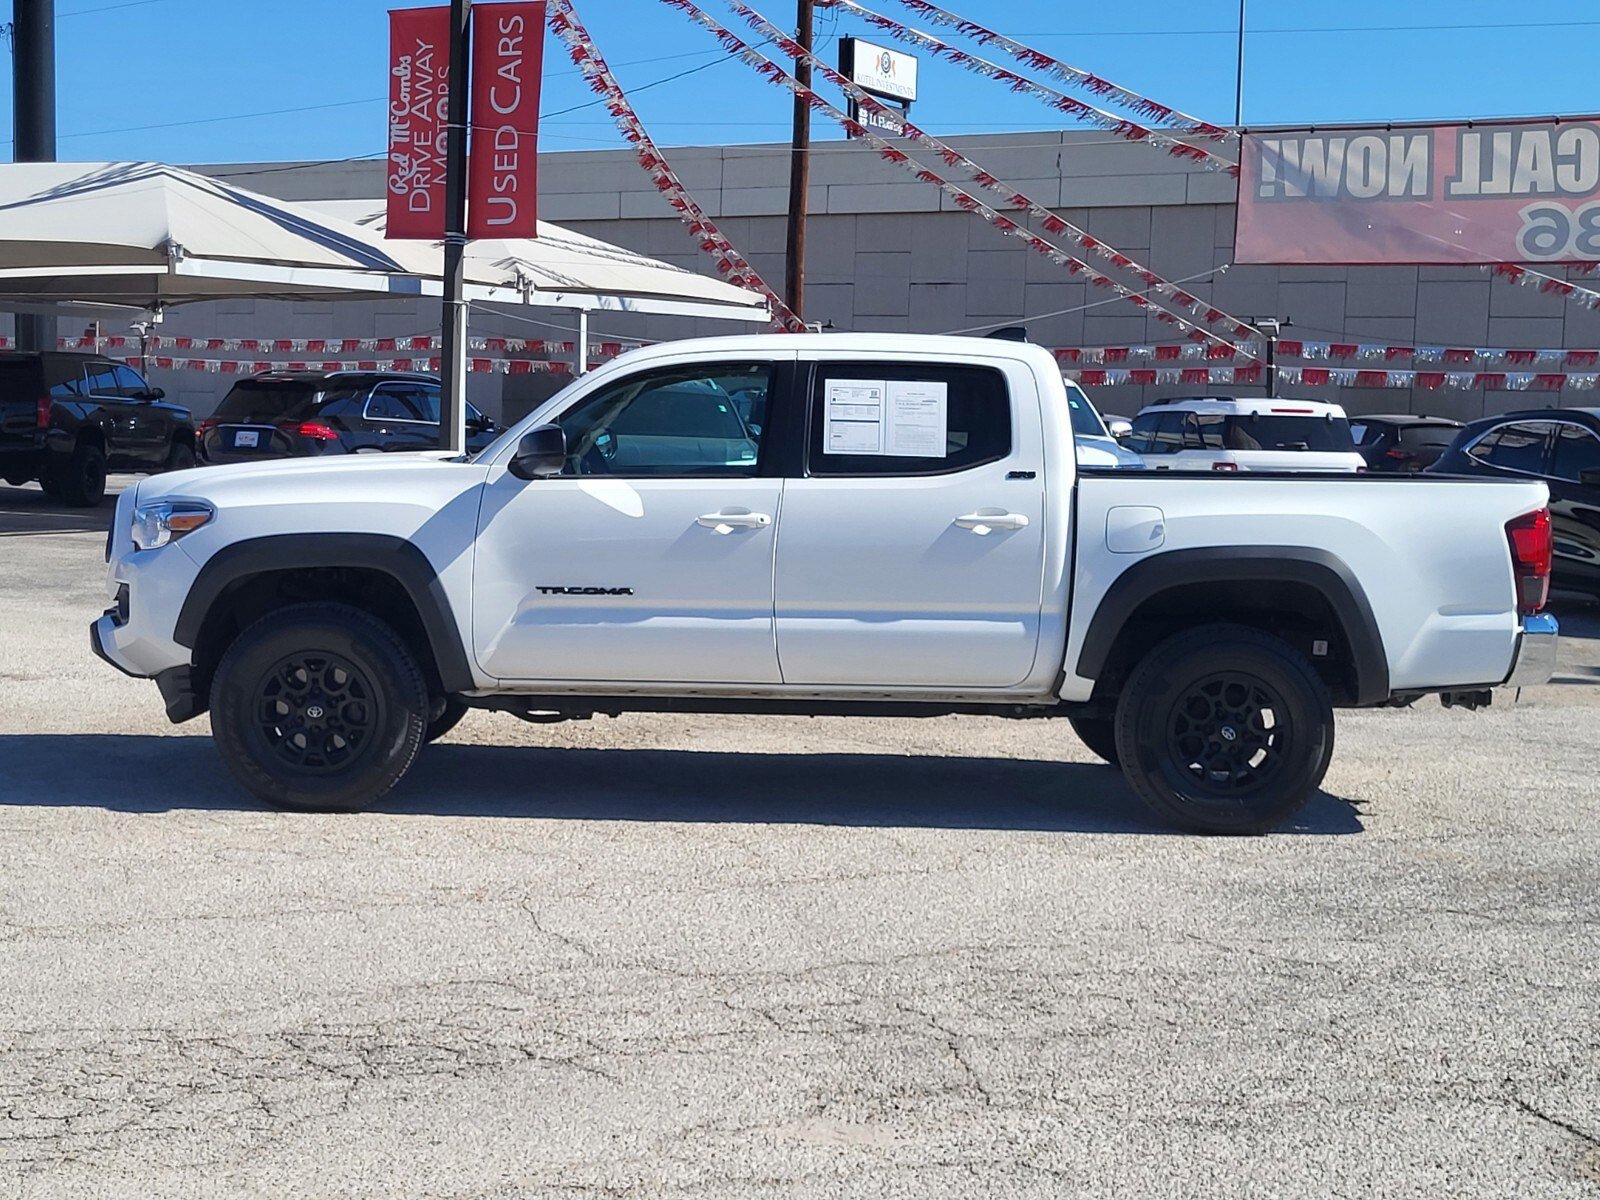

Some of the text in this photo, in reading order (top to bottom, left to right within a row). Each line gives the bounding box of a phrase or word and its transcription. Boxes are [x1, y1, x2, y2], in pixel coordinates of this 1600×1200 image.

[389, 152, 417, 195] Red
[409, 38, 434, 212] DRIVE AWAY
[487, 15, 524, 225] USED CARS
[535, 586, 634, 596] TACOMA
